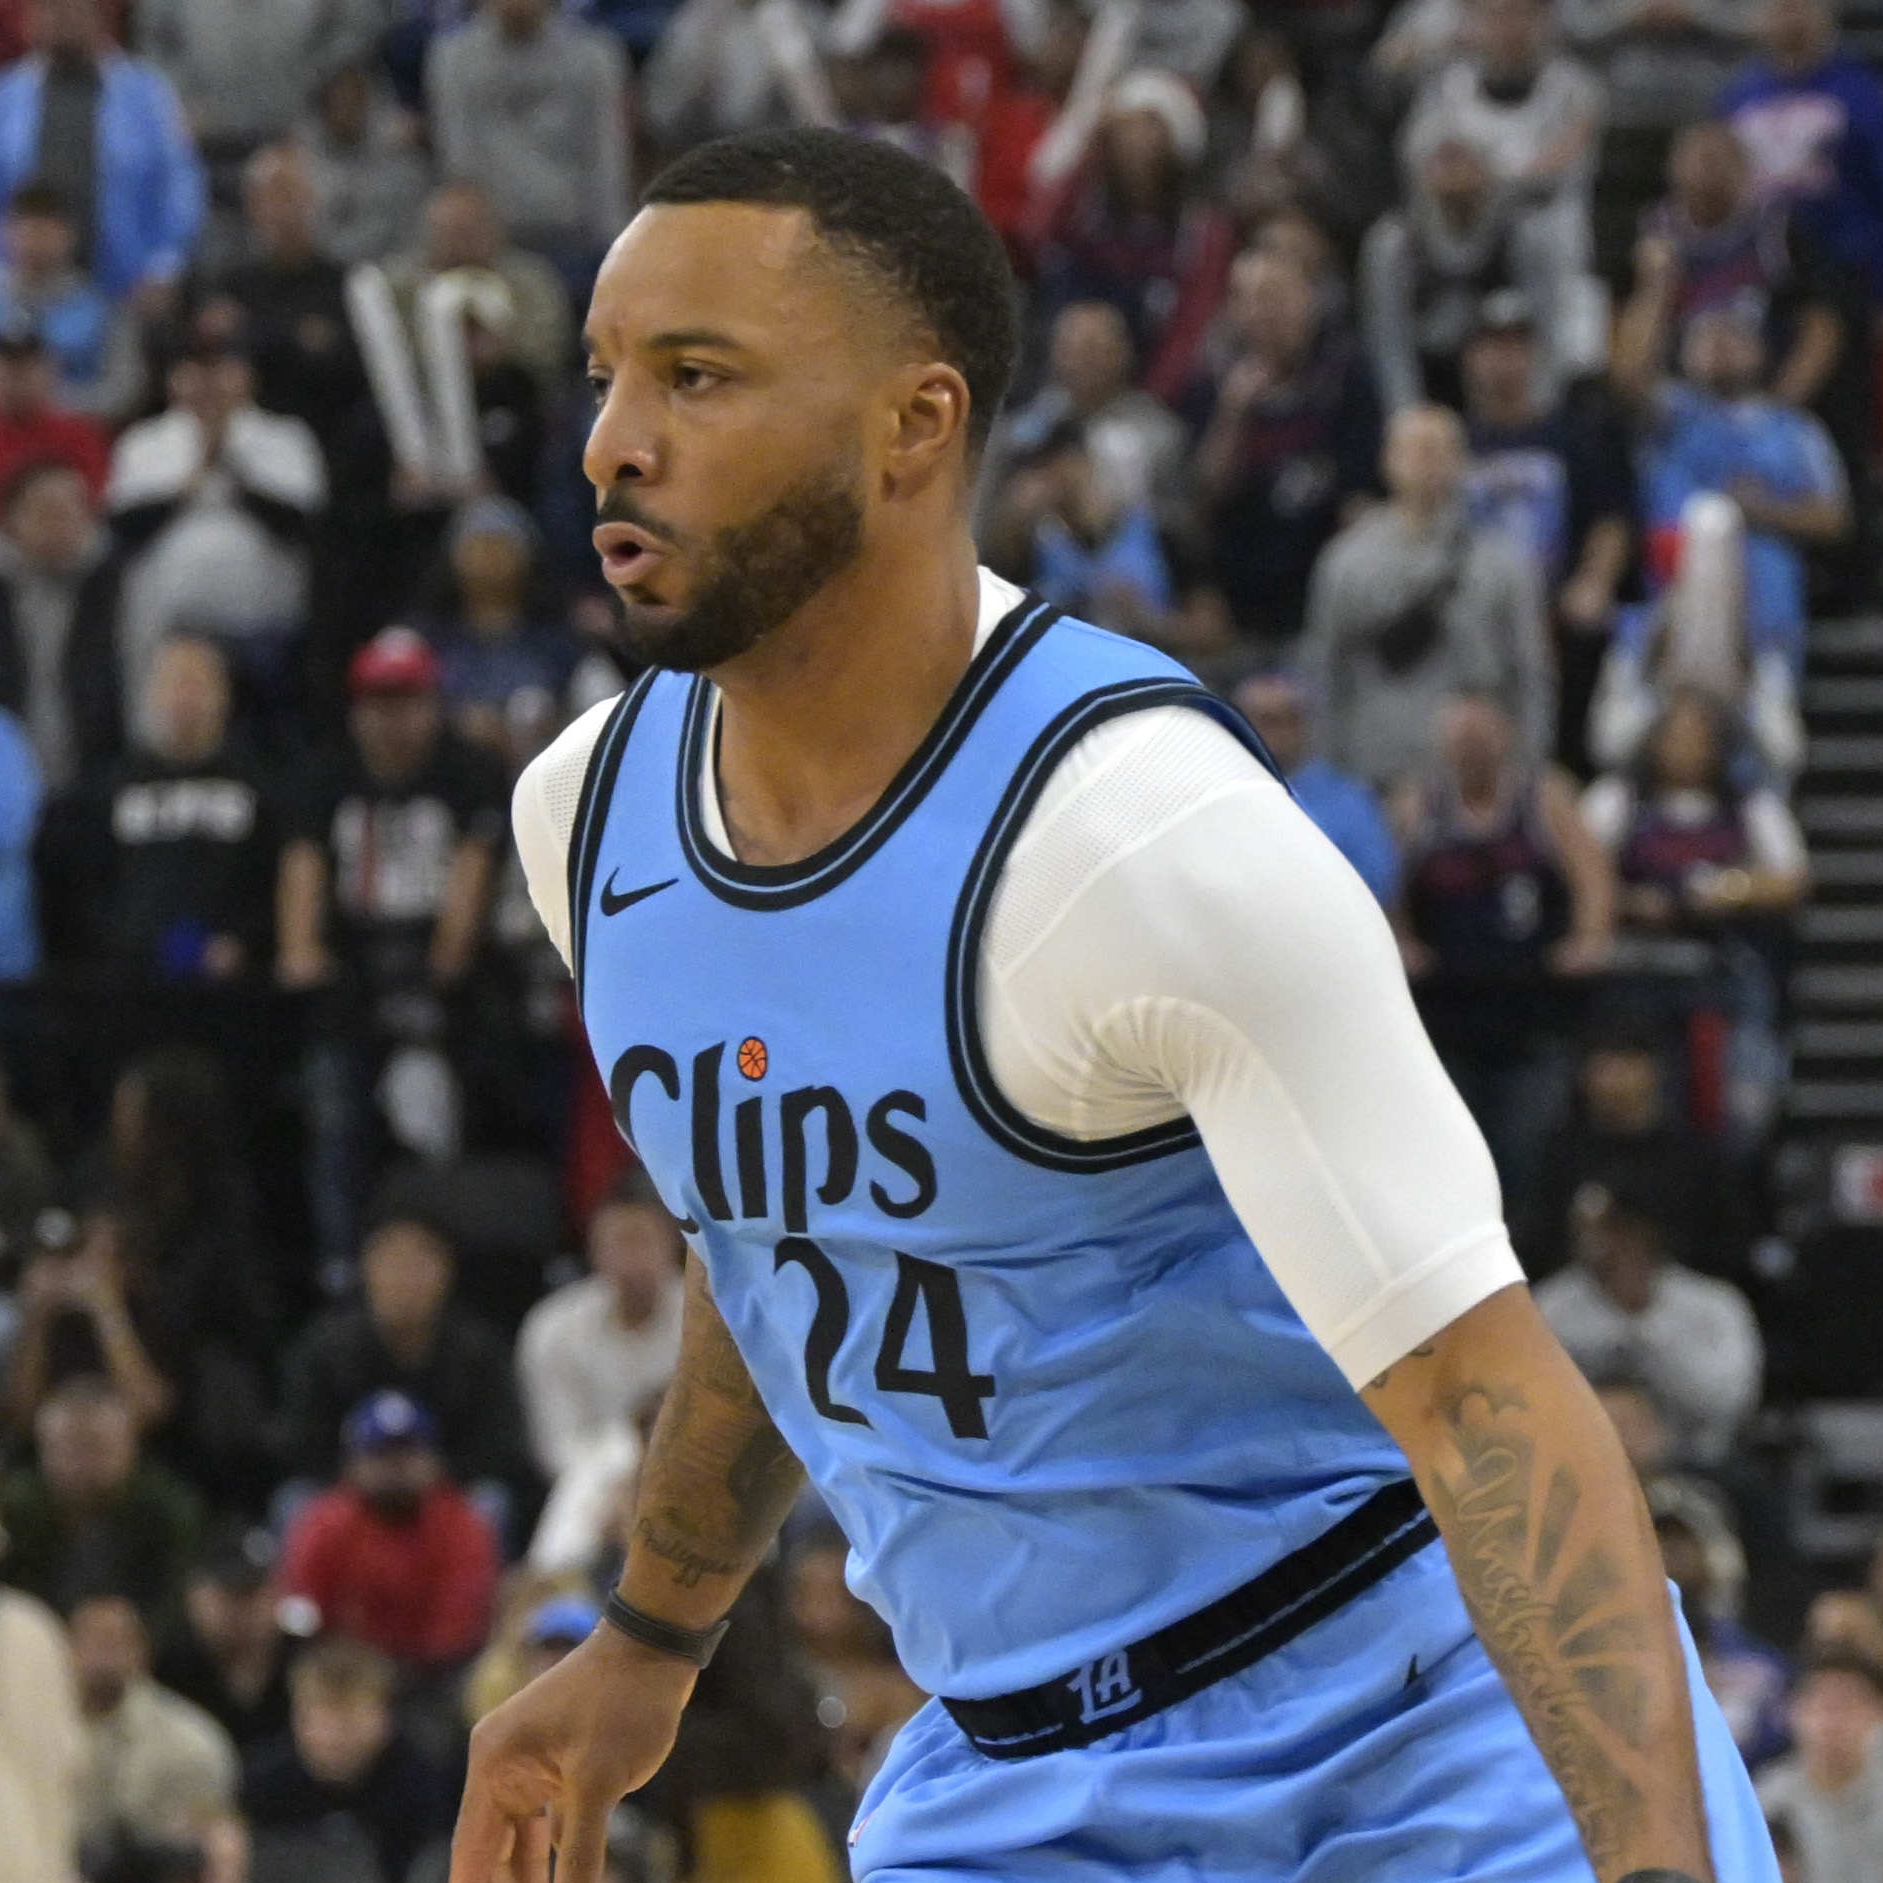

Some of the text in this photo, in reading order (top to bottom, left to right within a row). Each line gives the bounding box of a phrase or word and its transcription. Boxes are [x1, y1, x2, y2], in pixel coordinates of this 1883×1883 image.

[610, 1036, 937, 1235] Clips
[775, 1236, 995, 1440] 24
[1065, 1649, 1143, 1724] LA
